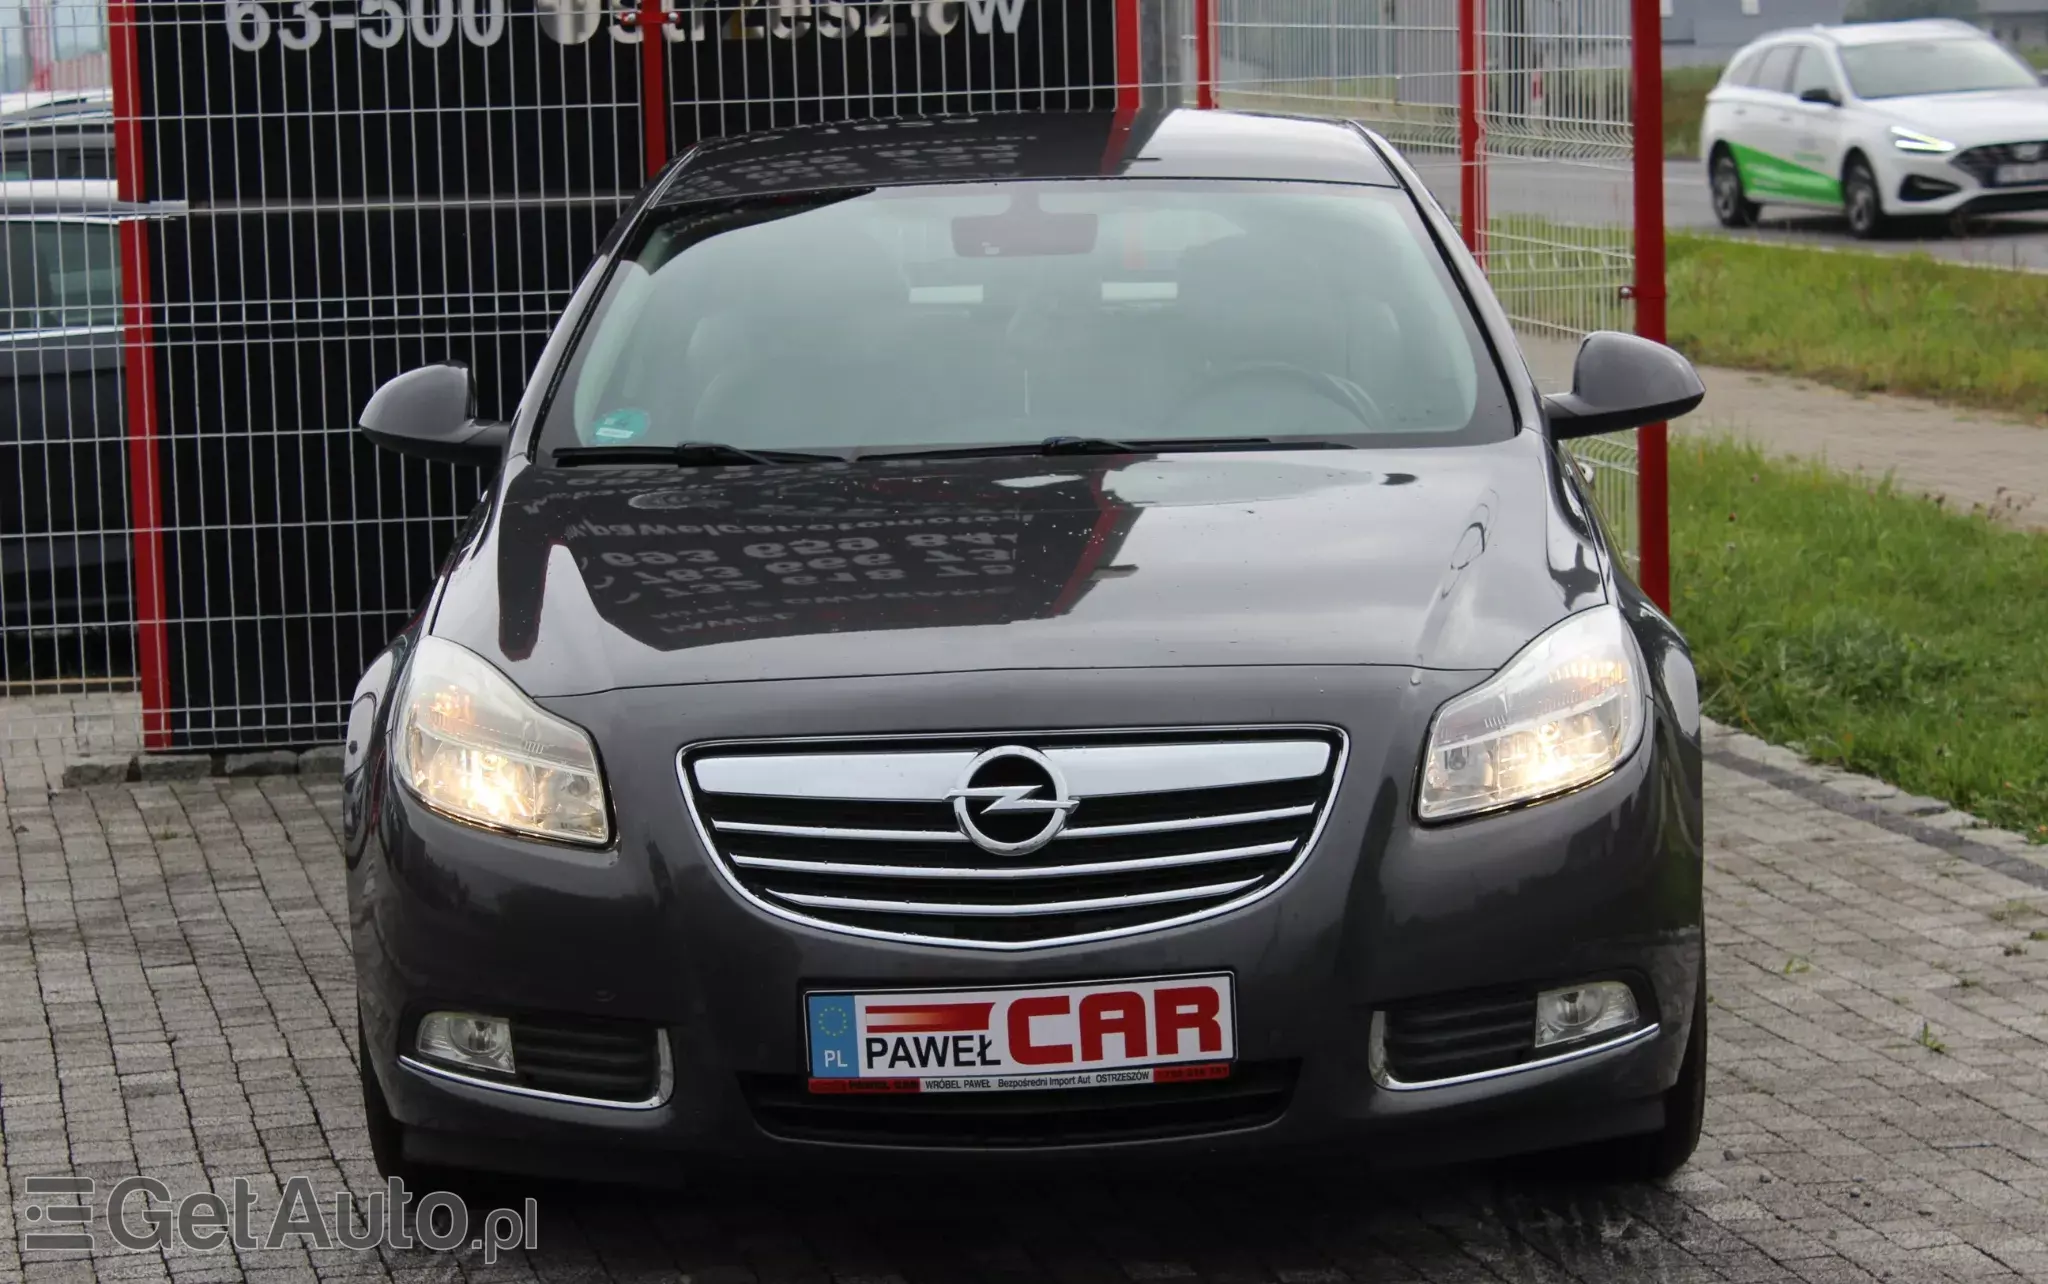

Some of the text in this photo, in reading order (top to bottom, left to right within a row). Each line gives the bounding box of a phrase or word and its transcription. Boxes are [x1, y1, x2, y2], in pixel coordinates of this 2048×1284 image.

[224, 0, 505, 51] 63-500
[866, 986, 1222, 1069] PAWEŁ CAR
[824, 1050, 847, 1068] PL
[925, 1077, 962, 1089] WRÓBEL
[998, 1075, 1048, 1089] Bezpośredni
[1049, 1074, 1075, 1087] Import
[1077, 1074, 1091, 1084] Aut
[1095, 1070, 1150, 1084] OSTRZESZÓW
